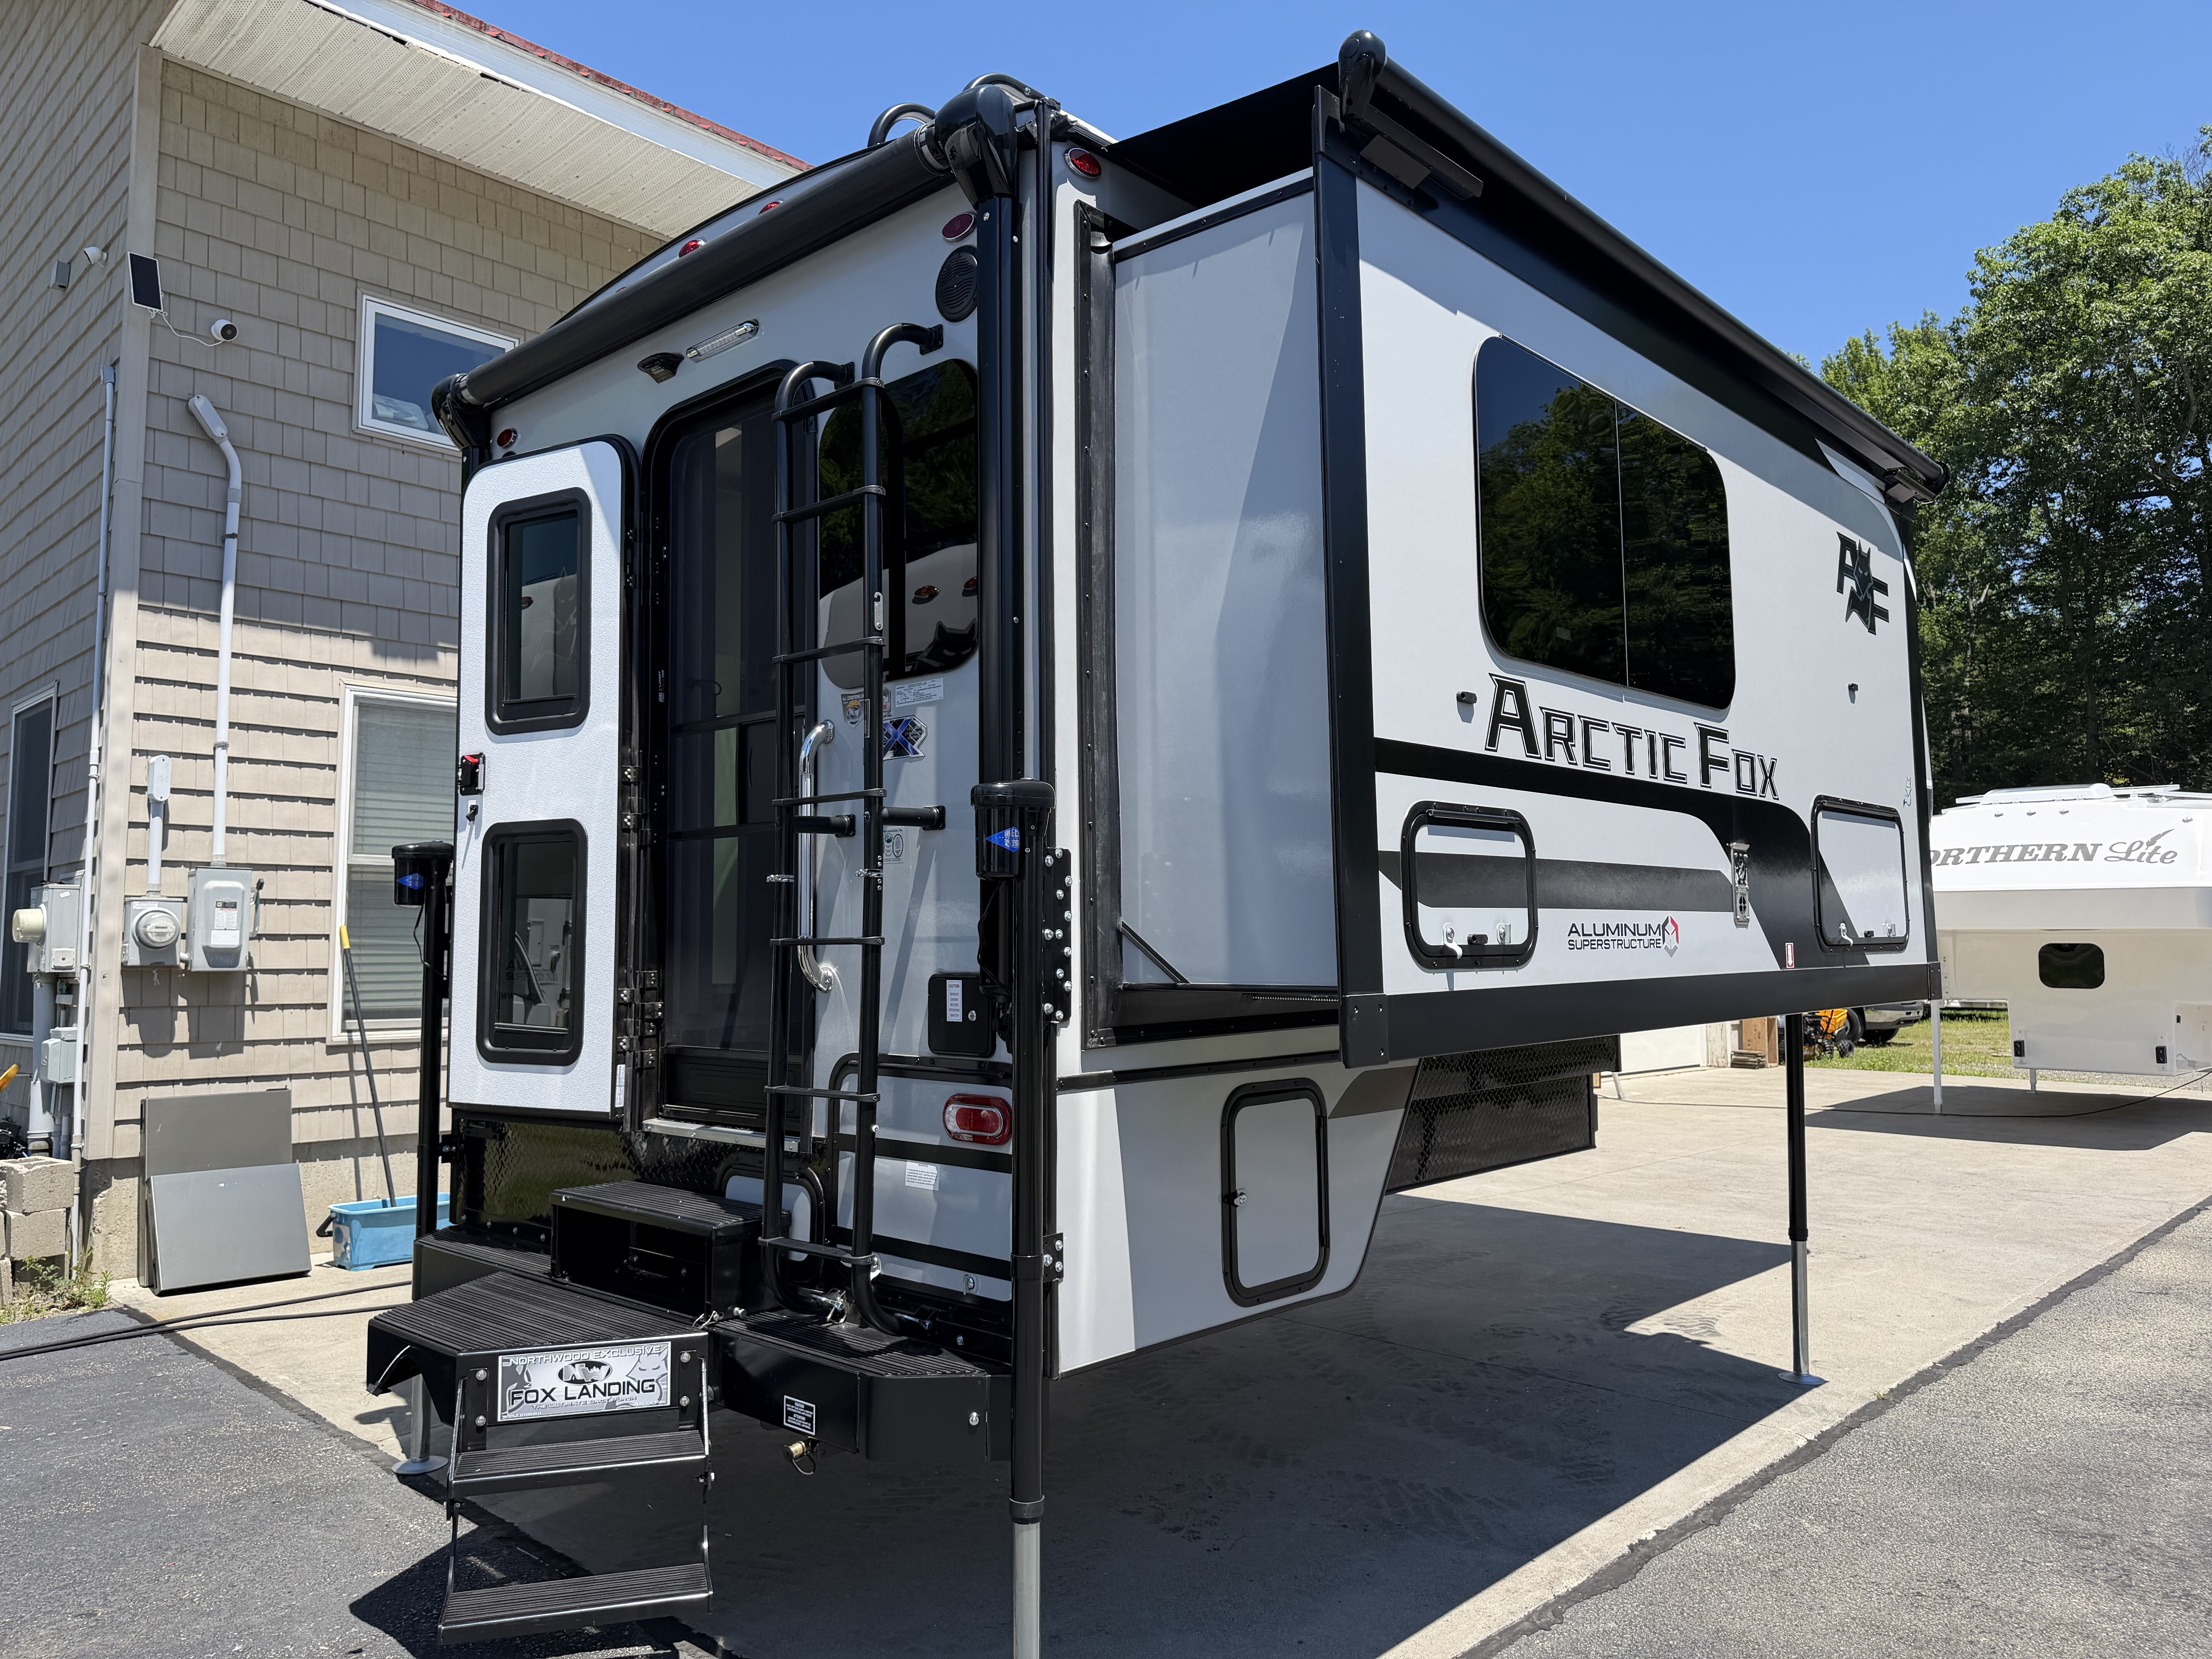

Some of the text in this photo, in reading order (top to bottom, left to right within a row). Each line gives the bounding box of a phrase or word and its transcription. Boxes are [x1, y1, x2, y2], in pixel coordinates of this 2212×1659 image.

[1930, 839, 2178, 866] ORTHERN Lite
[1568, 923, 1661, 937] ALUMINUM
[1568, 938, 1662, 950] SUPERSTRUCTURE
[510, 1345, 661, 1365] NORTHWOOD EXCLUSIVE
[511, 1379, 655, 1405] FOX LANDING
